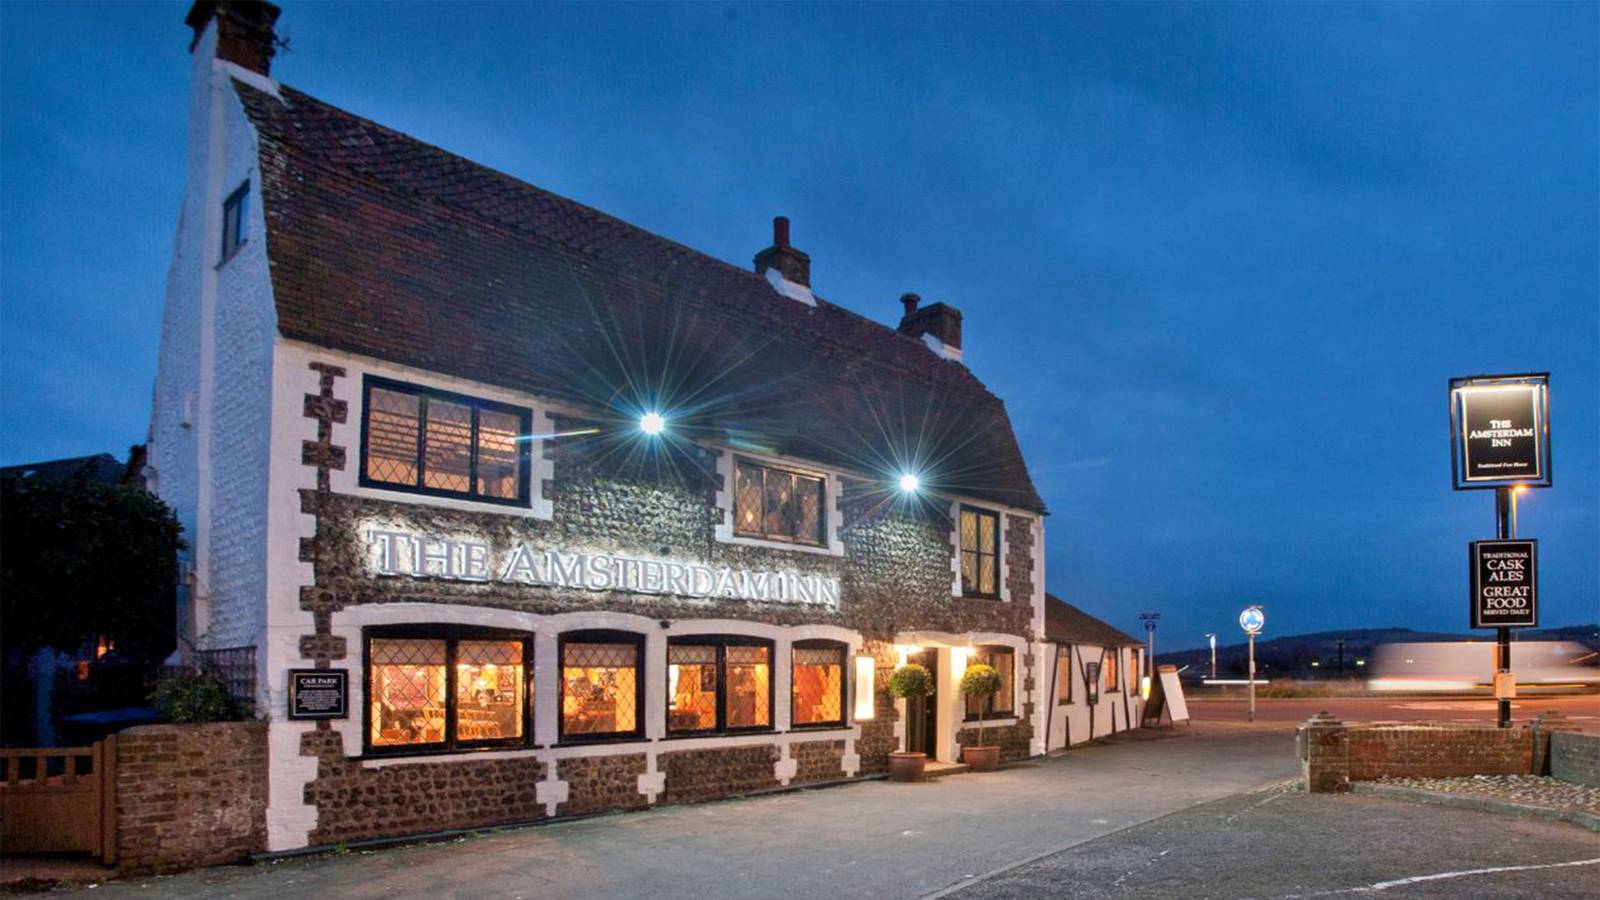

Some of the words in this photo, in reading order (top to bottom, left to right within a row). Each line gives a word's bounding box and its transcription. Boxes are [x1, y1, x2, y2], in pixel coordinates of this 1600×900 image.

[1489, 419, 1512, 429] THE
[1469, 428, 1534, 439] AMSTERDAM
[1491, 438, 1512, 447] INN
[370, 529, 489, 581] THE
[502, 543, 772, 602] AMSTERDAM
[776, 571, 841, 607] INN
[1486, 559, 1525, 570] CASK
[1489, 570, 1524, 582] ALES
[1483, 586, 1530, 597] GREAT
[1486, 597, 1527, 609] FOOD
